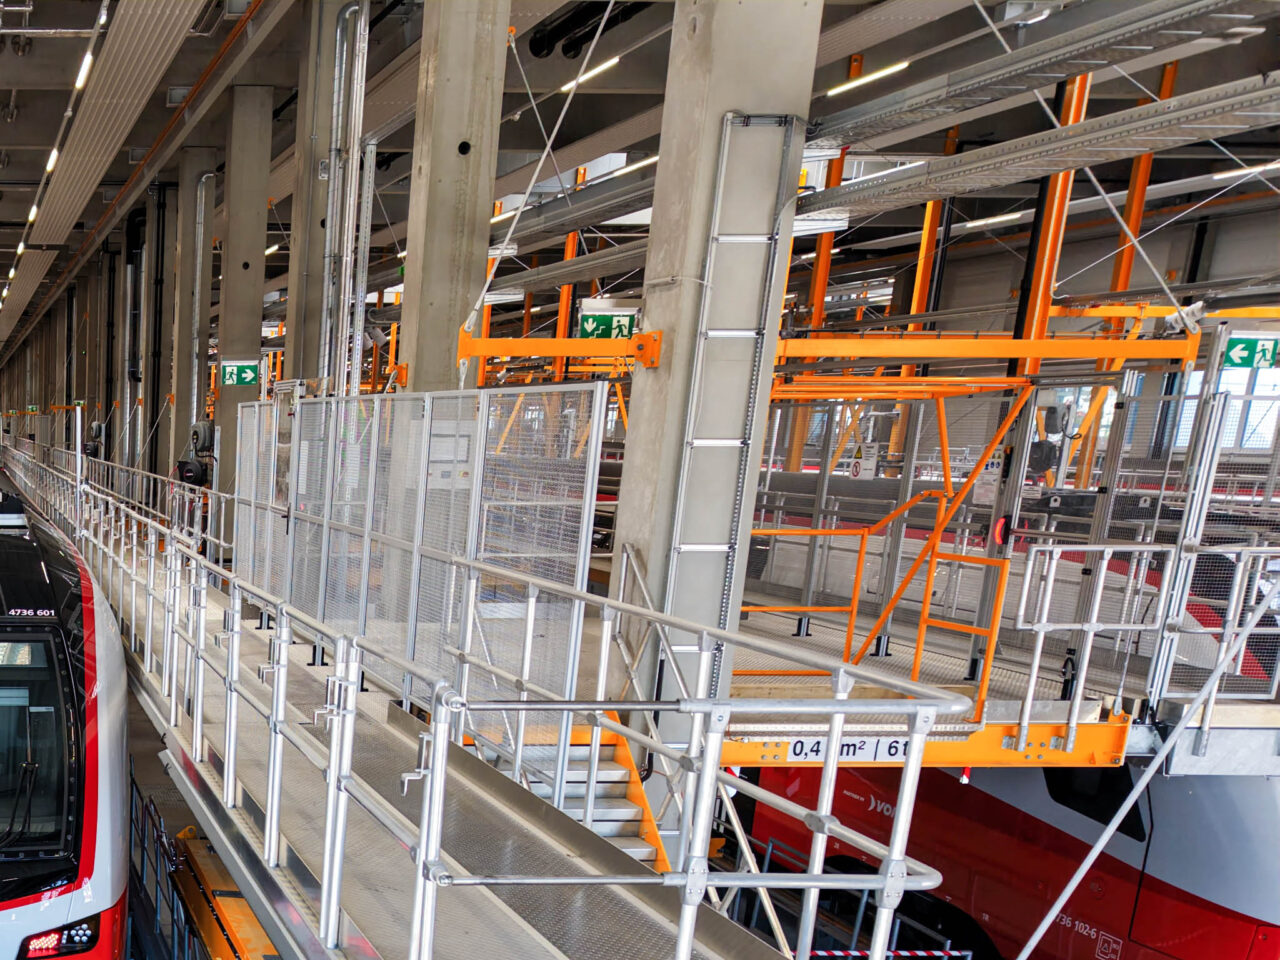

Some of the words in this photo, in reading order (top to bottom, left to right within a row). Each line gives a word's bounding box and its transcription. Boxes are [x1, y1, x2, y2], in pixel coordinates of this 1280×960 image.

[8, 608, 35, 617] 4736
[36, 609, 56, 617] 601
[887, 740, 900, 757] 6
[1074, 920, 1098, 939] 102-6
